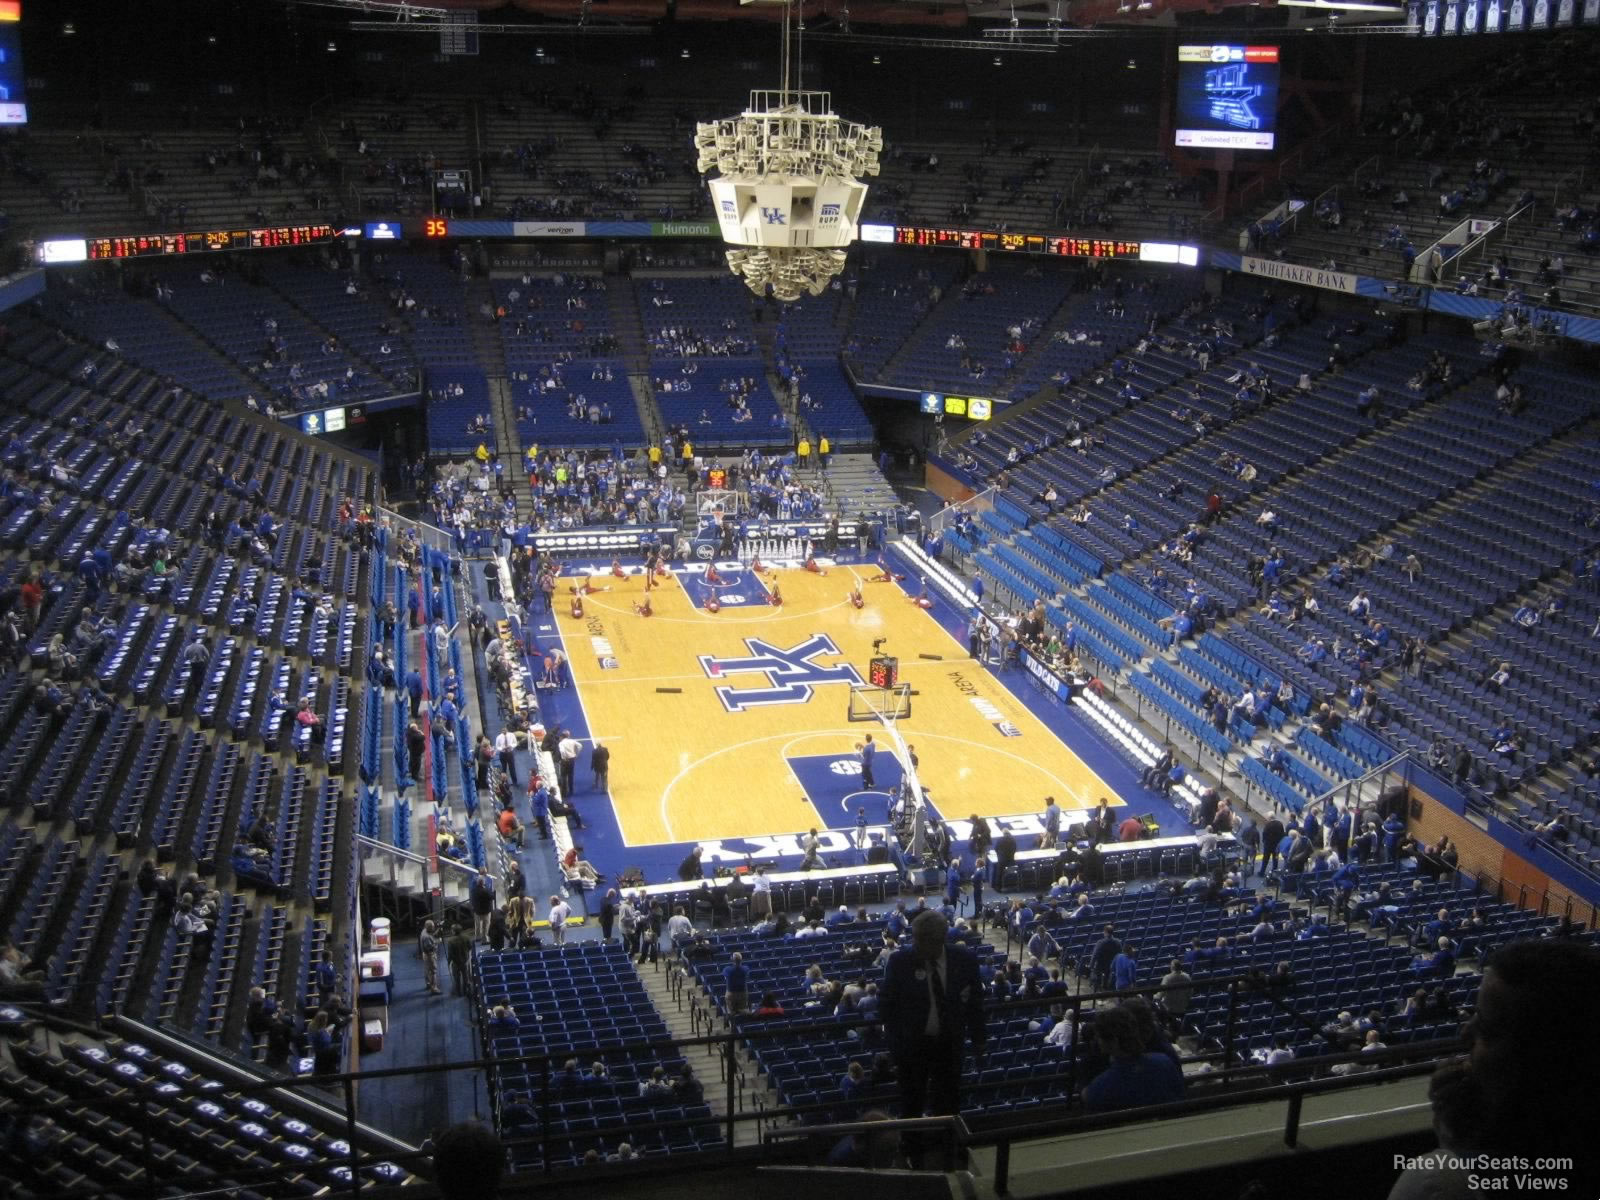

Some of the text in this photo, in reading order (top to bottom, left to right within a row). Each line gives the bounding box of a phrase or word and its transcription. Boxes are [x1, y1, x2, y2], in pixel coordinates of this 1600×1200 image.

[1200, 135, 1231, 144] Unlimited
[761, 207, 787, 225] UK
[819, 216, 839, 224] RUPP
[427, 221, 446, 236] 35
[547, 227, 574, 235] verizon
[662, 223, 710, 235] Humana
[1260, 261, 1346, 290] WHITAKER BANK
[697, 632, 869, 713] UK
[872, 670, 885, 687] 35
[1025, 654, 1061, 693] WILDCATS
[946, 671, 982, 697] ARENA
